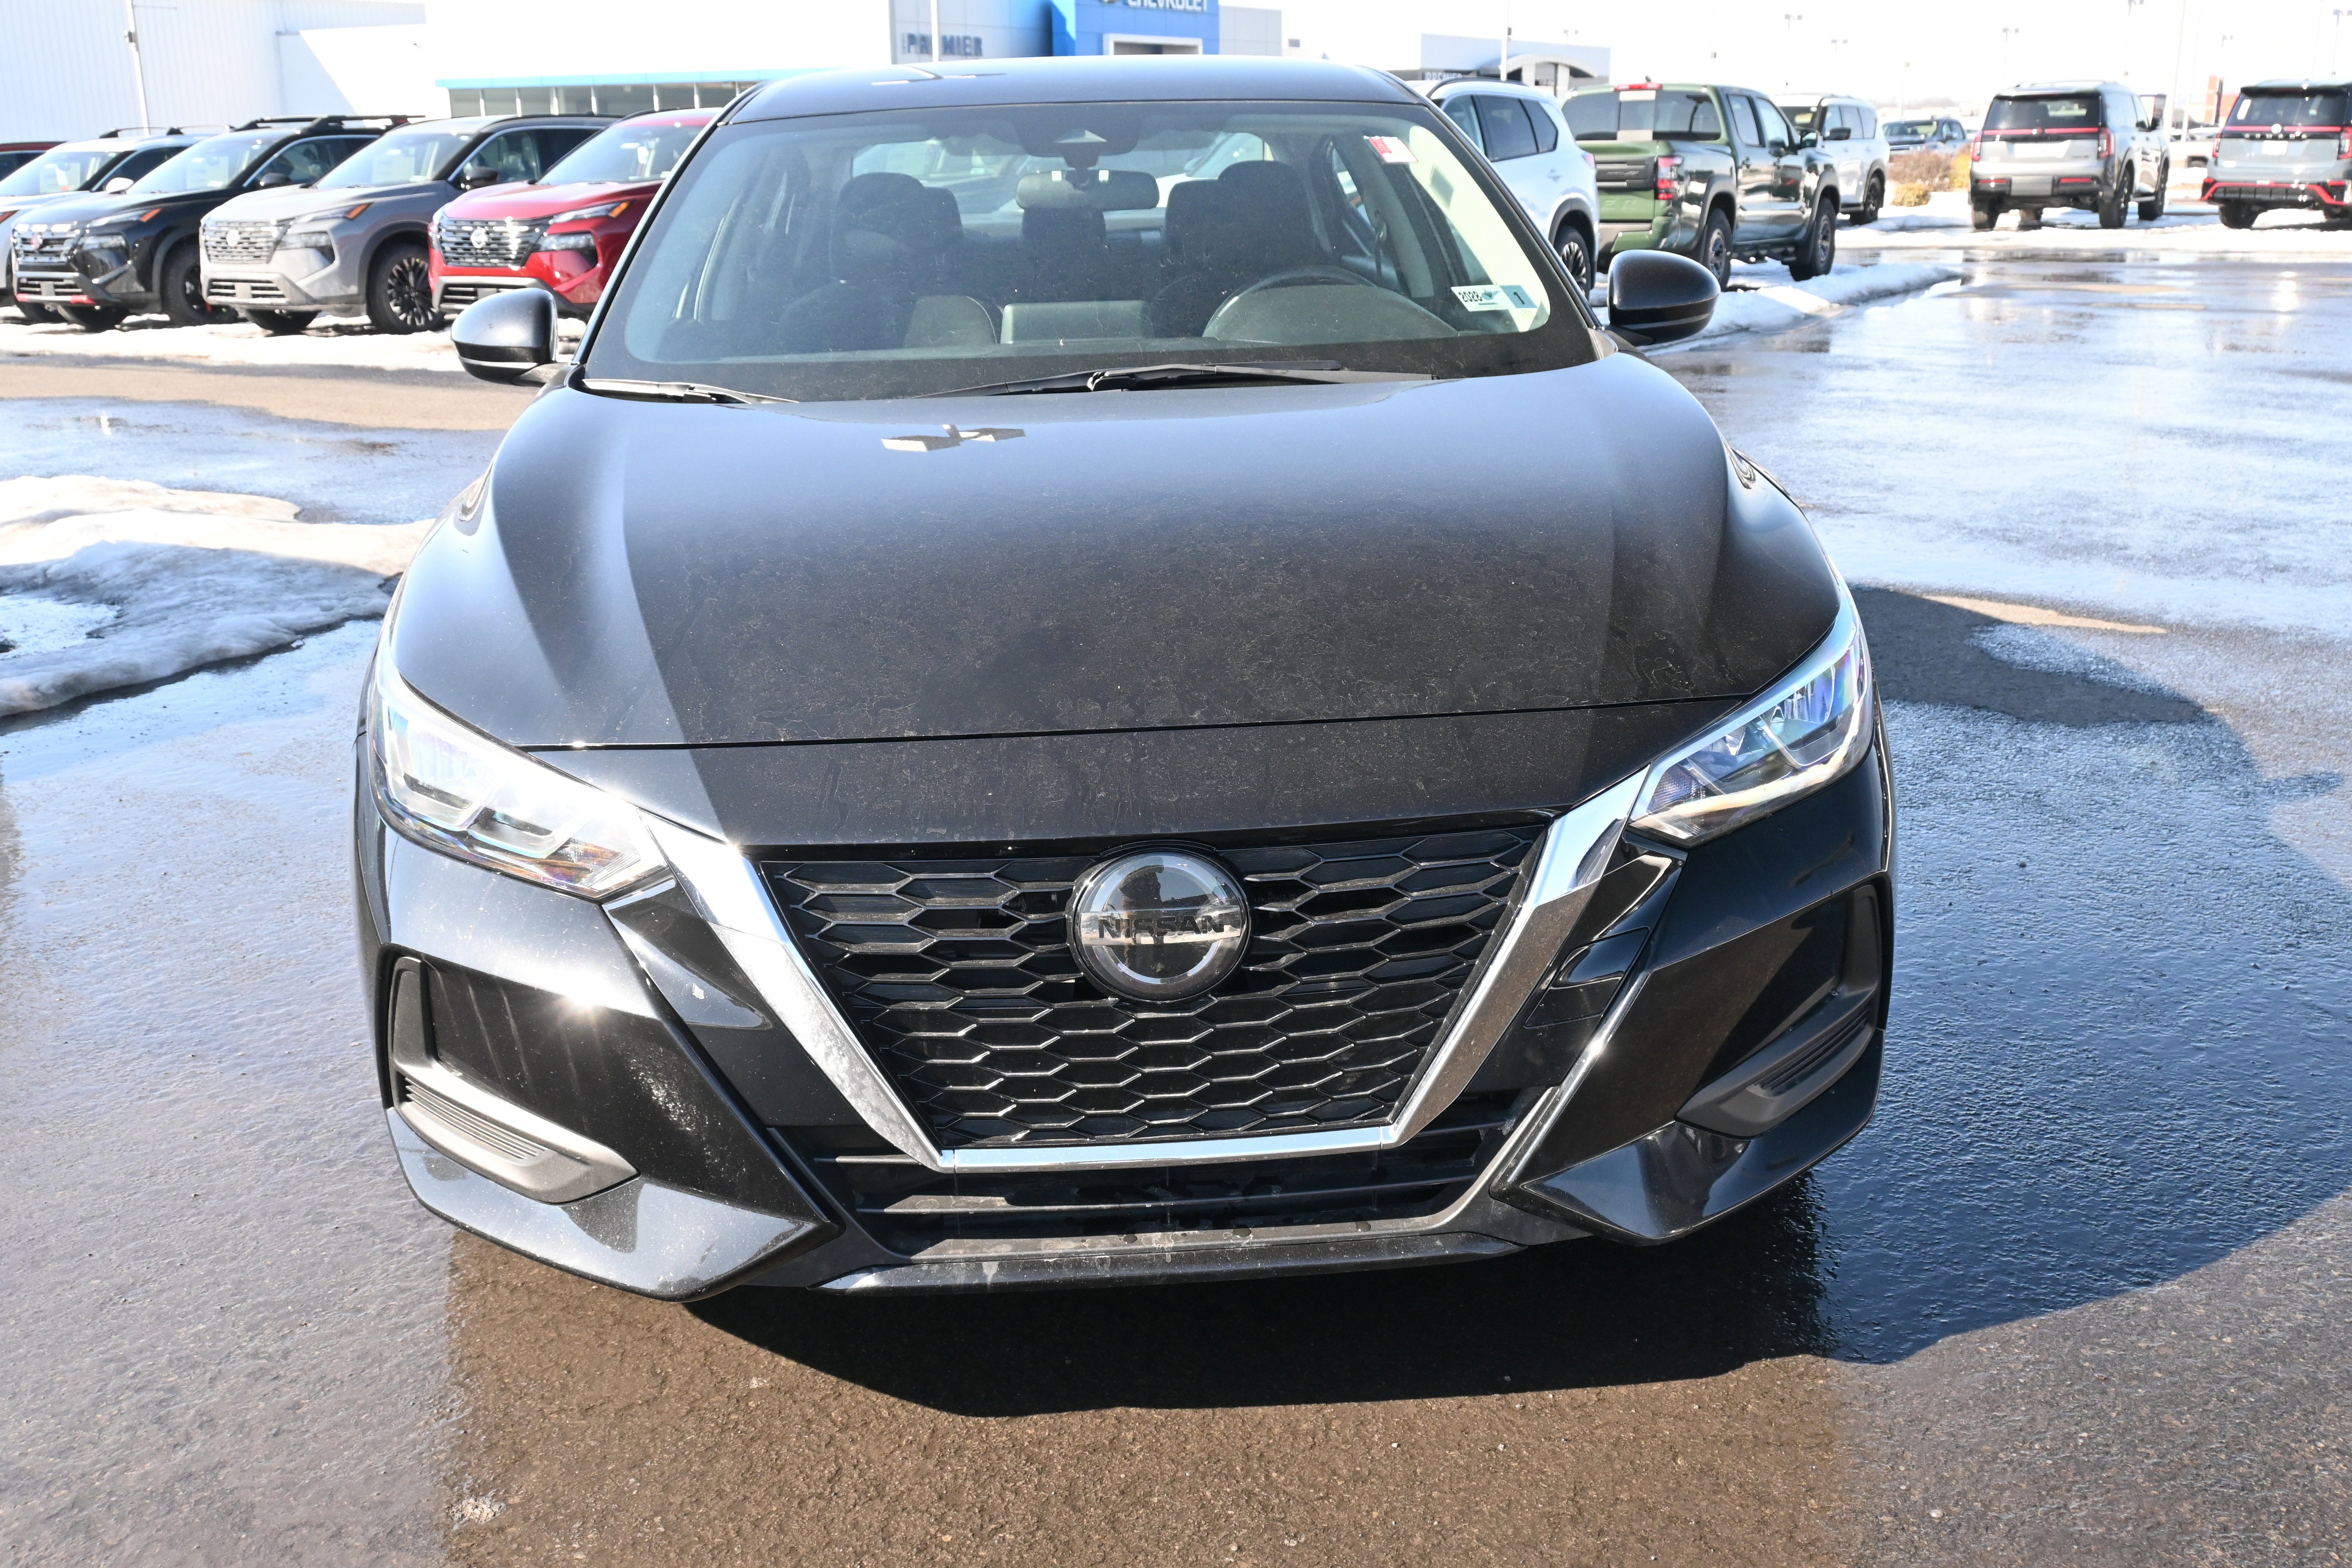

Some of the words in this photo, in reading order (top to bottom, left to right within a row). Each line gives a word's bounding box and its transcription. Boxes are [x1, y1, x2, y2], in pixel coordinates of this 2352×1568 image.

[906, 33, 982, 56] PRMIER
[1513, 291, 1525, 305] 1
[1098, 914, 1225, 939] NISSAN
